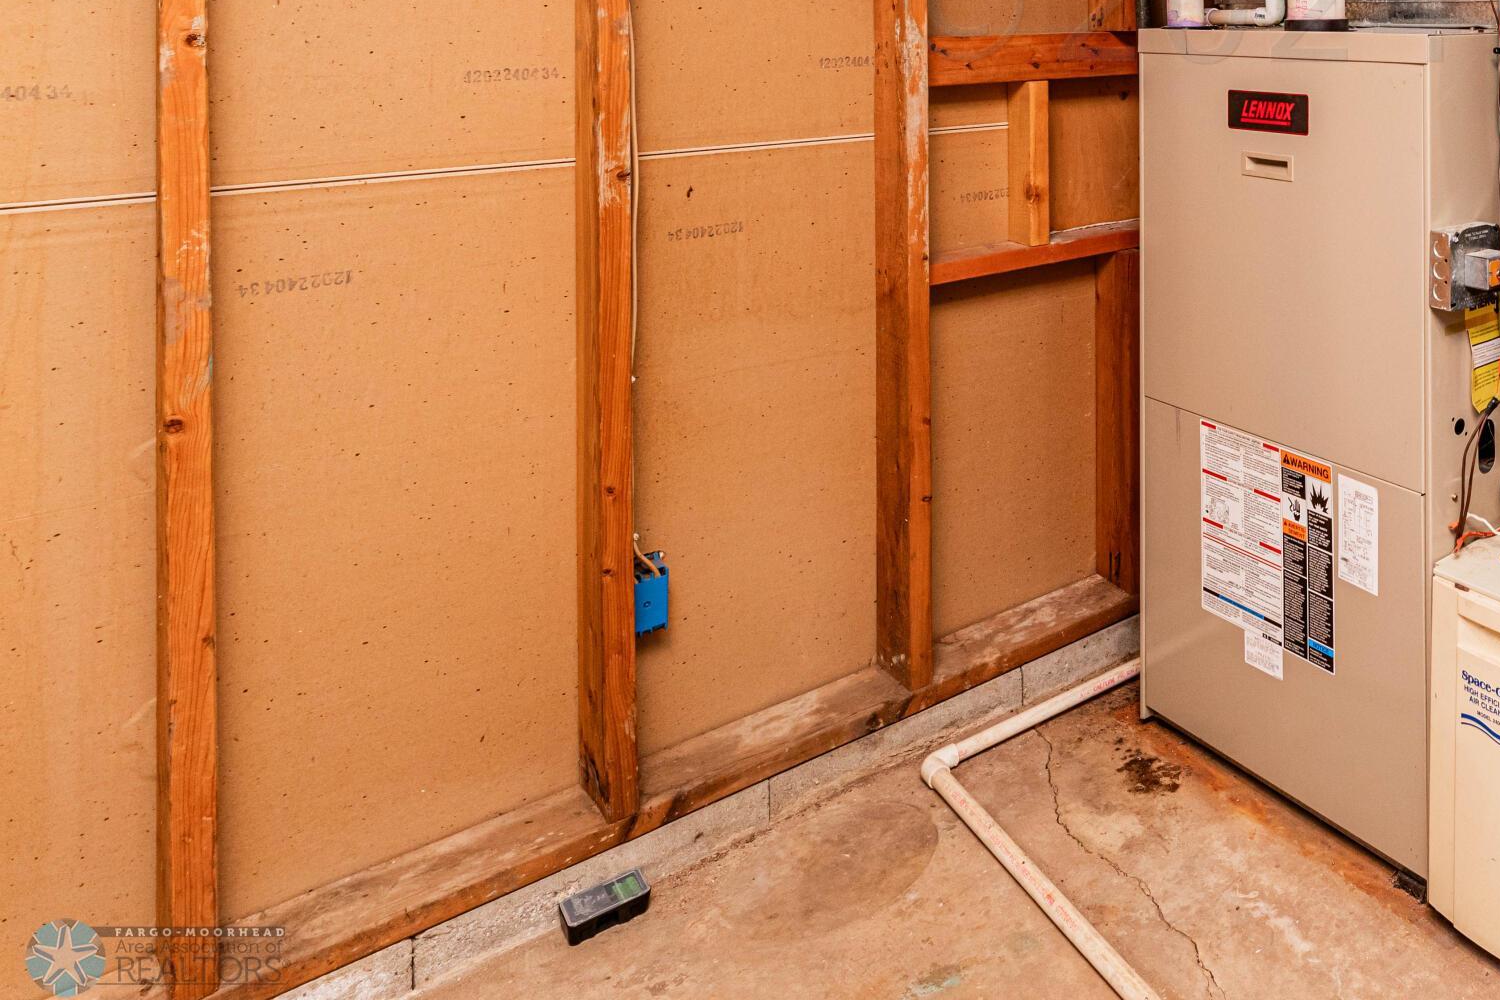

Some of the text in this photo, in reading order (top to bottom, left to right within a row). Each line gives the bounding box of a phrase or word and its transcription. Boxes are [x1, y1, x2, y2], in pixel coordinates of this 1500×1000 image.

[1241, 99, 1295, 121] LENNOX
[1289, 456, 1329, 480] WARNING
[1464, 684, 1479, 697] HIGH
[1470, 696, 1479, 706] AIR
